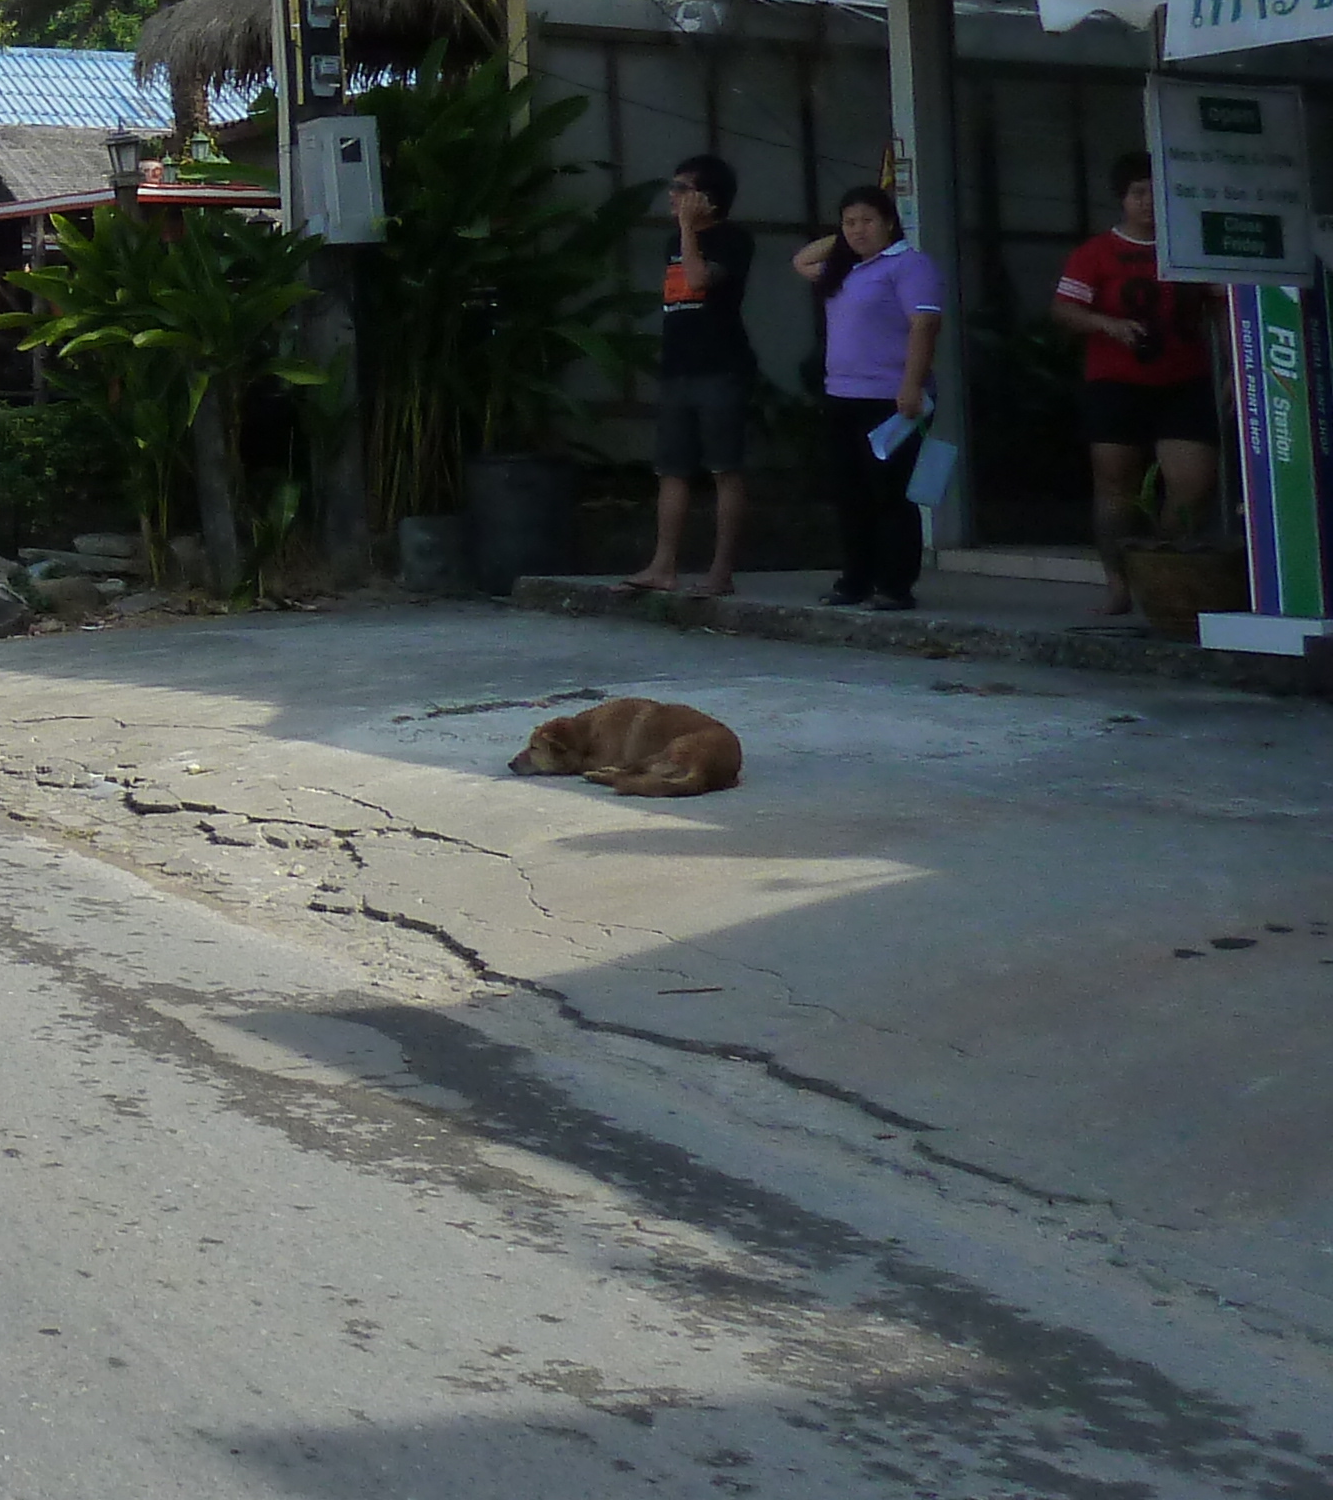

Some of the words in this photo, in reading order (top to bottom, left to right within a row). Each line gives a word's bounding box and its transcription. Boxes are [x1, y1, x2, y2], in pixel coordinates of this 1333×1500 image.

[1241, 320, 1255, 370] DIGITAL
[1246, 375, 1259, 415] PRINT
[1250, 416, 1262, 455] SHOP
[1272, 396, 1292, 463] Station
